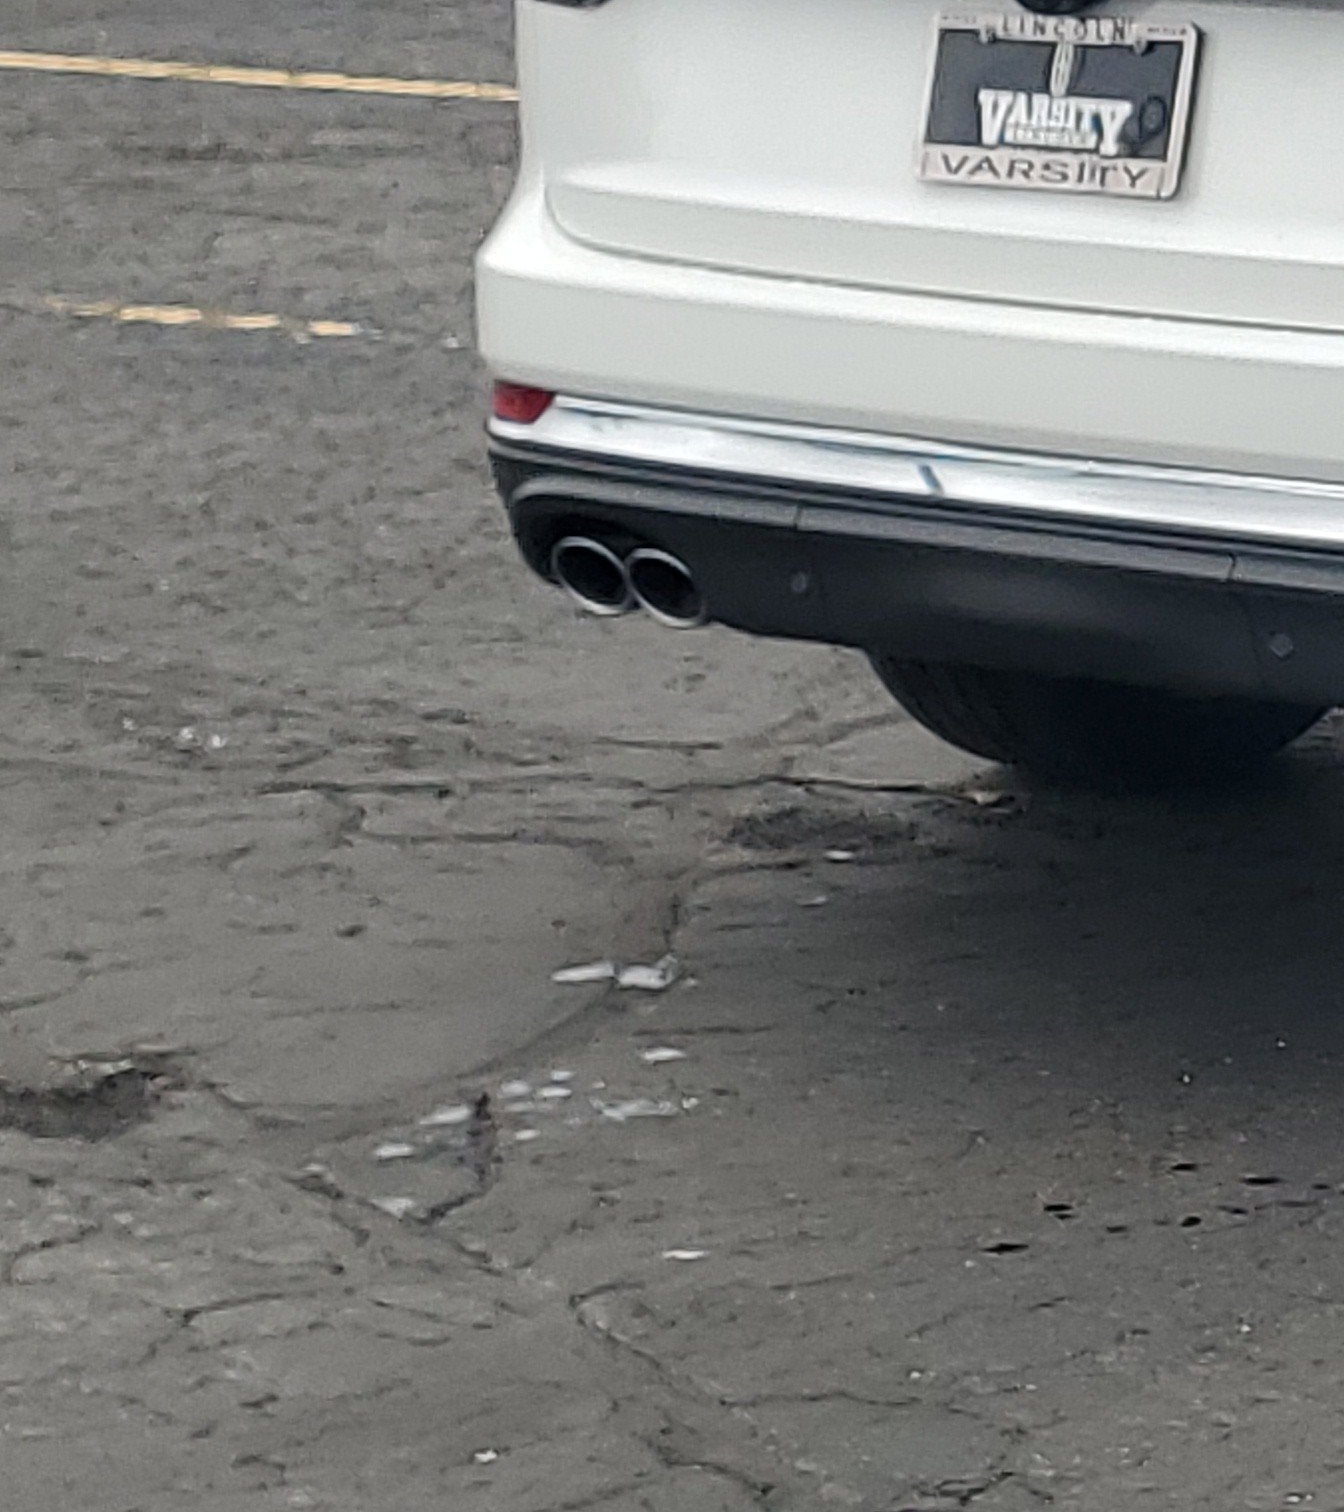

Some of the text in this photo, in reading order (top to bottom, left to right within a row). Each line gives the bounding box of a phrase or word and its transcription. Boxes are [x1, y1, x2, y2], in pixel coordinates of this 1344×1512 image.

[1002, 14, 1126, 40] LINCOLN
[977, 87, 1133, 157] VARSITY
[940, 152, 1149, 189] VARSITY
